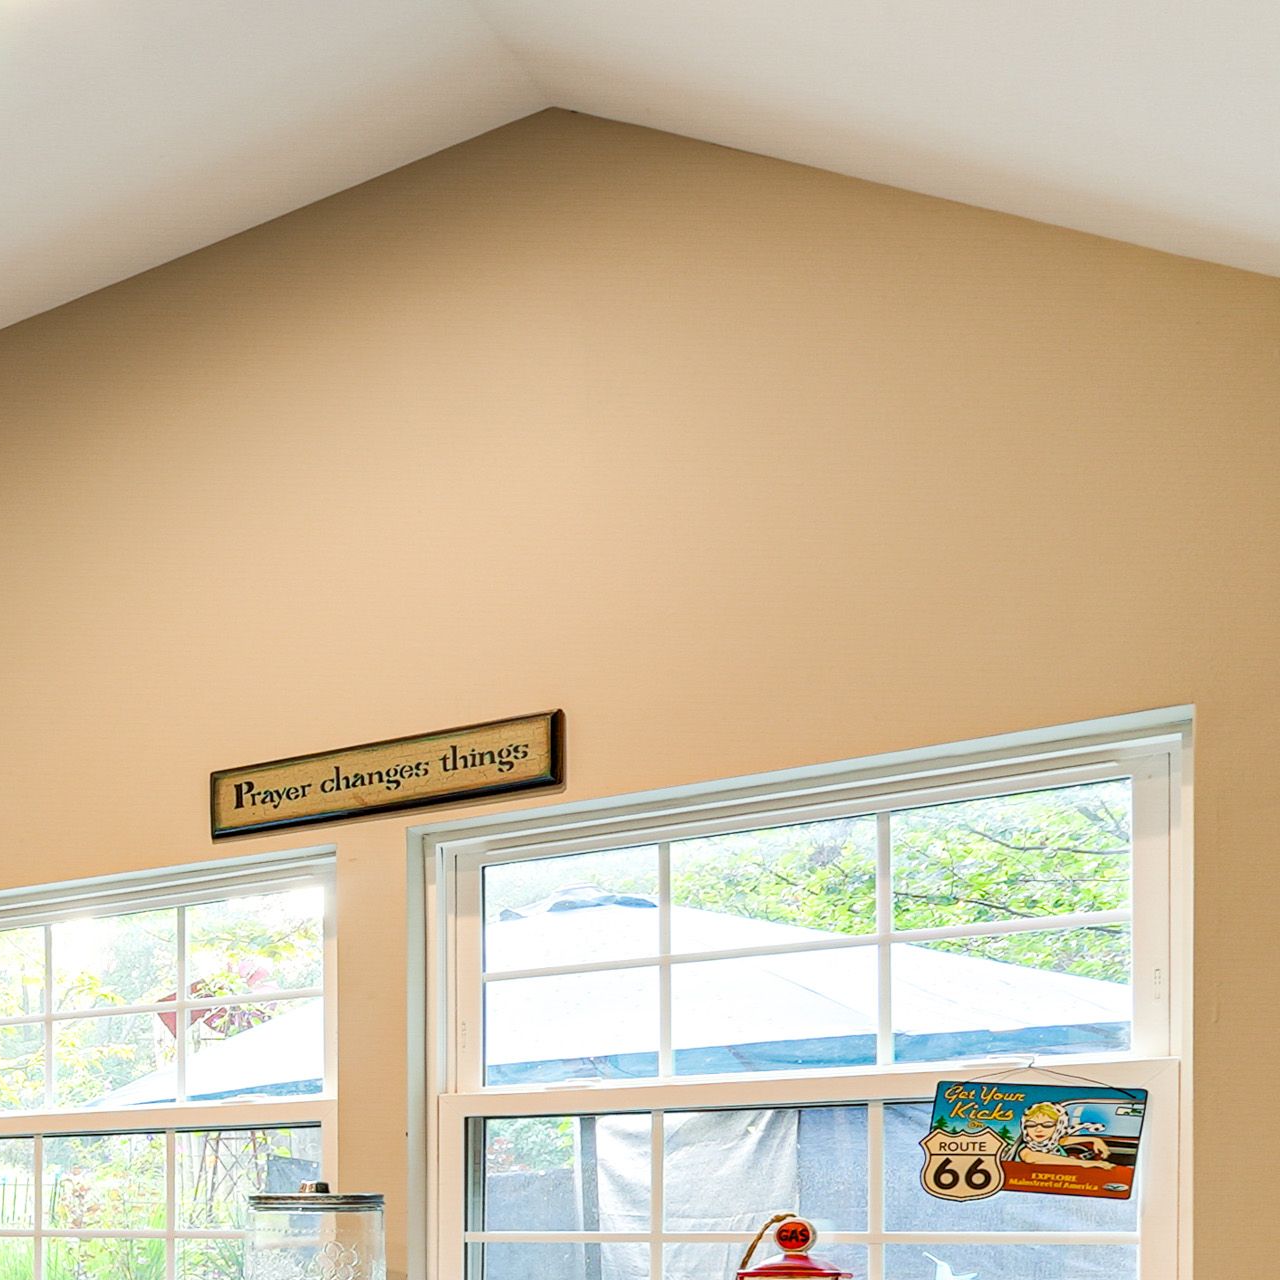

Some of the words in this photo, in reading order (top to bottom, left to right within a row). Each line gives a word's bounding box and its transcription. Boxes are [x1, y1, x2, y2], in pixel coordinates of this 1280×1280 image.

[233, 780, 312, 810] Prayer
[320, 765, 430, 791] changes
[440, 743, 529, 773] things
[944, 1085, 976, 1103] Get
[981, 1086, 1025, 1105] Your
[950, 1101, 1014, 1120] Kicks
[939, 1141, 987, 1152] ROUTE
[933, 1157, 992, 1190] 66
[1031, 1172, 1078, 1182] EXPLORE
[1063, 1181, 1099, 1191] America
[778, 1228, 810, 1243] GAS
